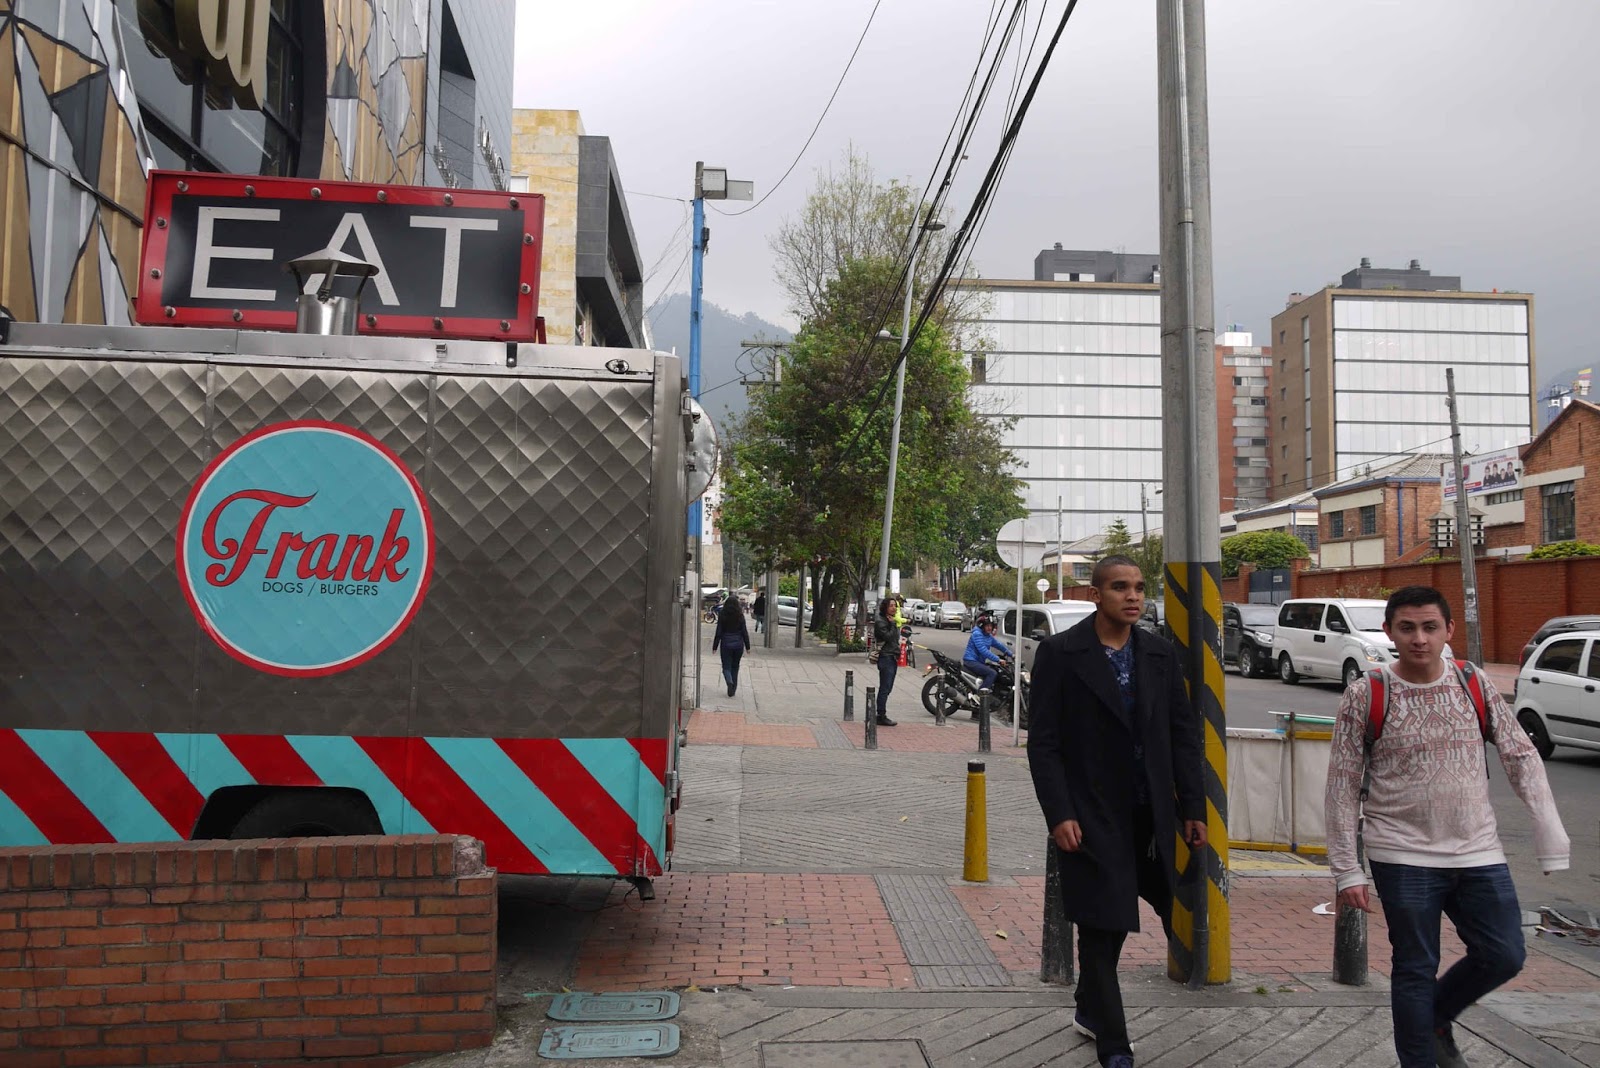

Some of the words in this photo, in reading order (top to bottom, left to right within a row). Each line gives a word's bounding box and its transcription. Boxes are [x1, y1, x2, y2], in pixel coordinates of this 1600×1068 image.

[189, 206, 499, 308] EAT
[201, 489, 411, 587] Frank
[262, 581, 304, 594] DOGS
[320, 582, 379, 596] BURGERS
